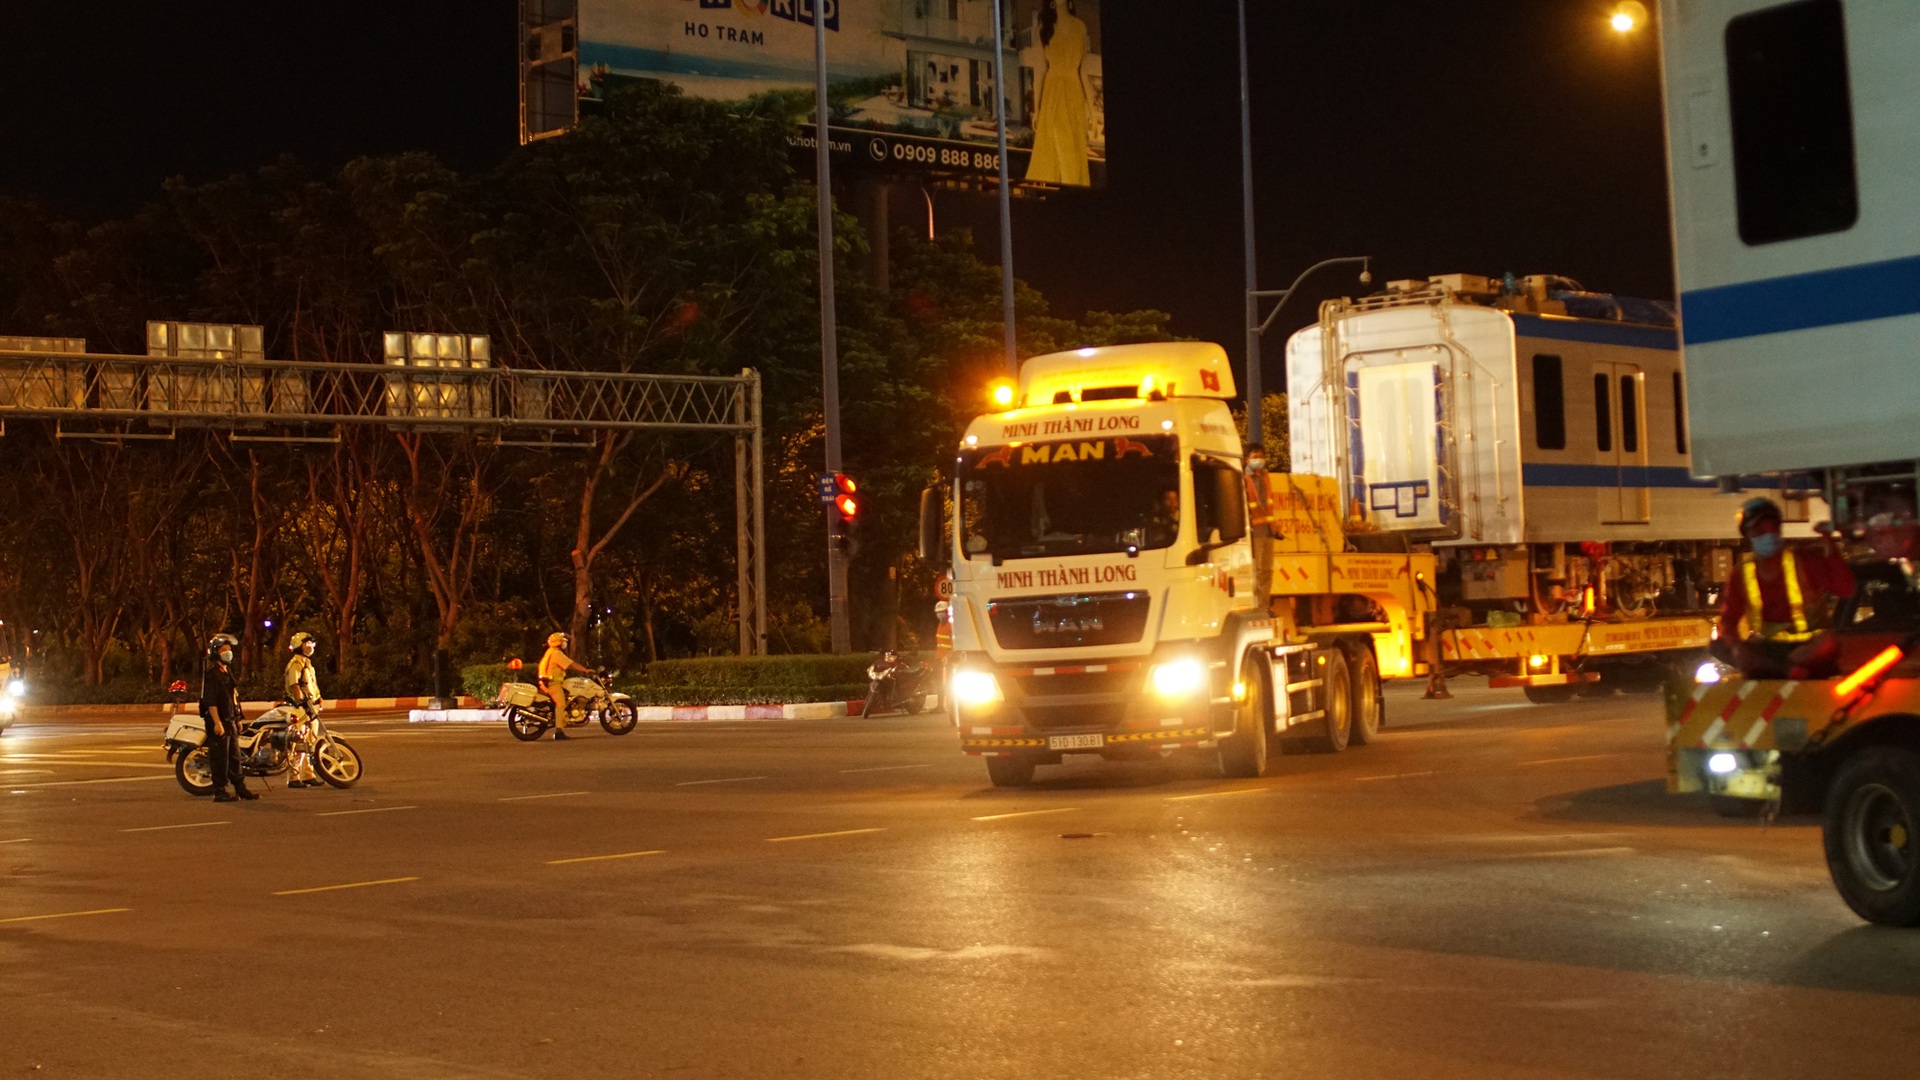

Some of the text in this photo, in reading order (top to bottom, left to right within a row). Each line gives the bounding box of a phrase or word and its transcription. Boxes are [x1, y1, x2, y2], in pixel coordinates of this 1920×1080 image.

[684, 21, 764, 46] HO TRAM
[893, 143, 936, 163] 0909
[941, 148, 969, 166] 888
[1002, 415, 1140, 438] MINH THÀNH LONG
[1021, 441, 1105, 465] MAN
[997, 564, 1137, 589] MINH THÀNH LONG
[941, 582, 953, 595] 80
